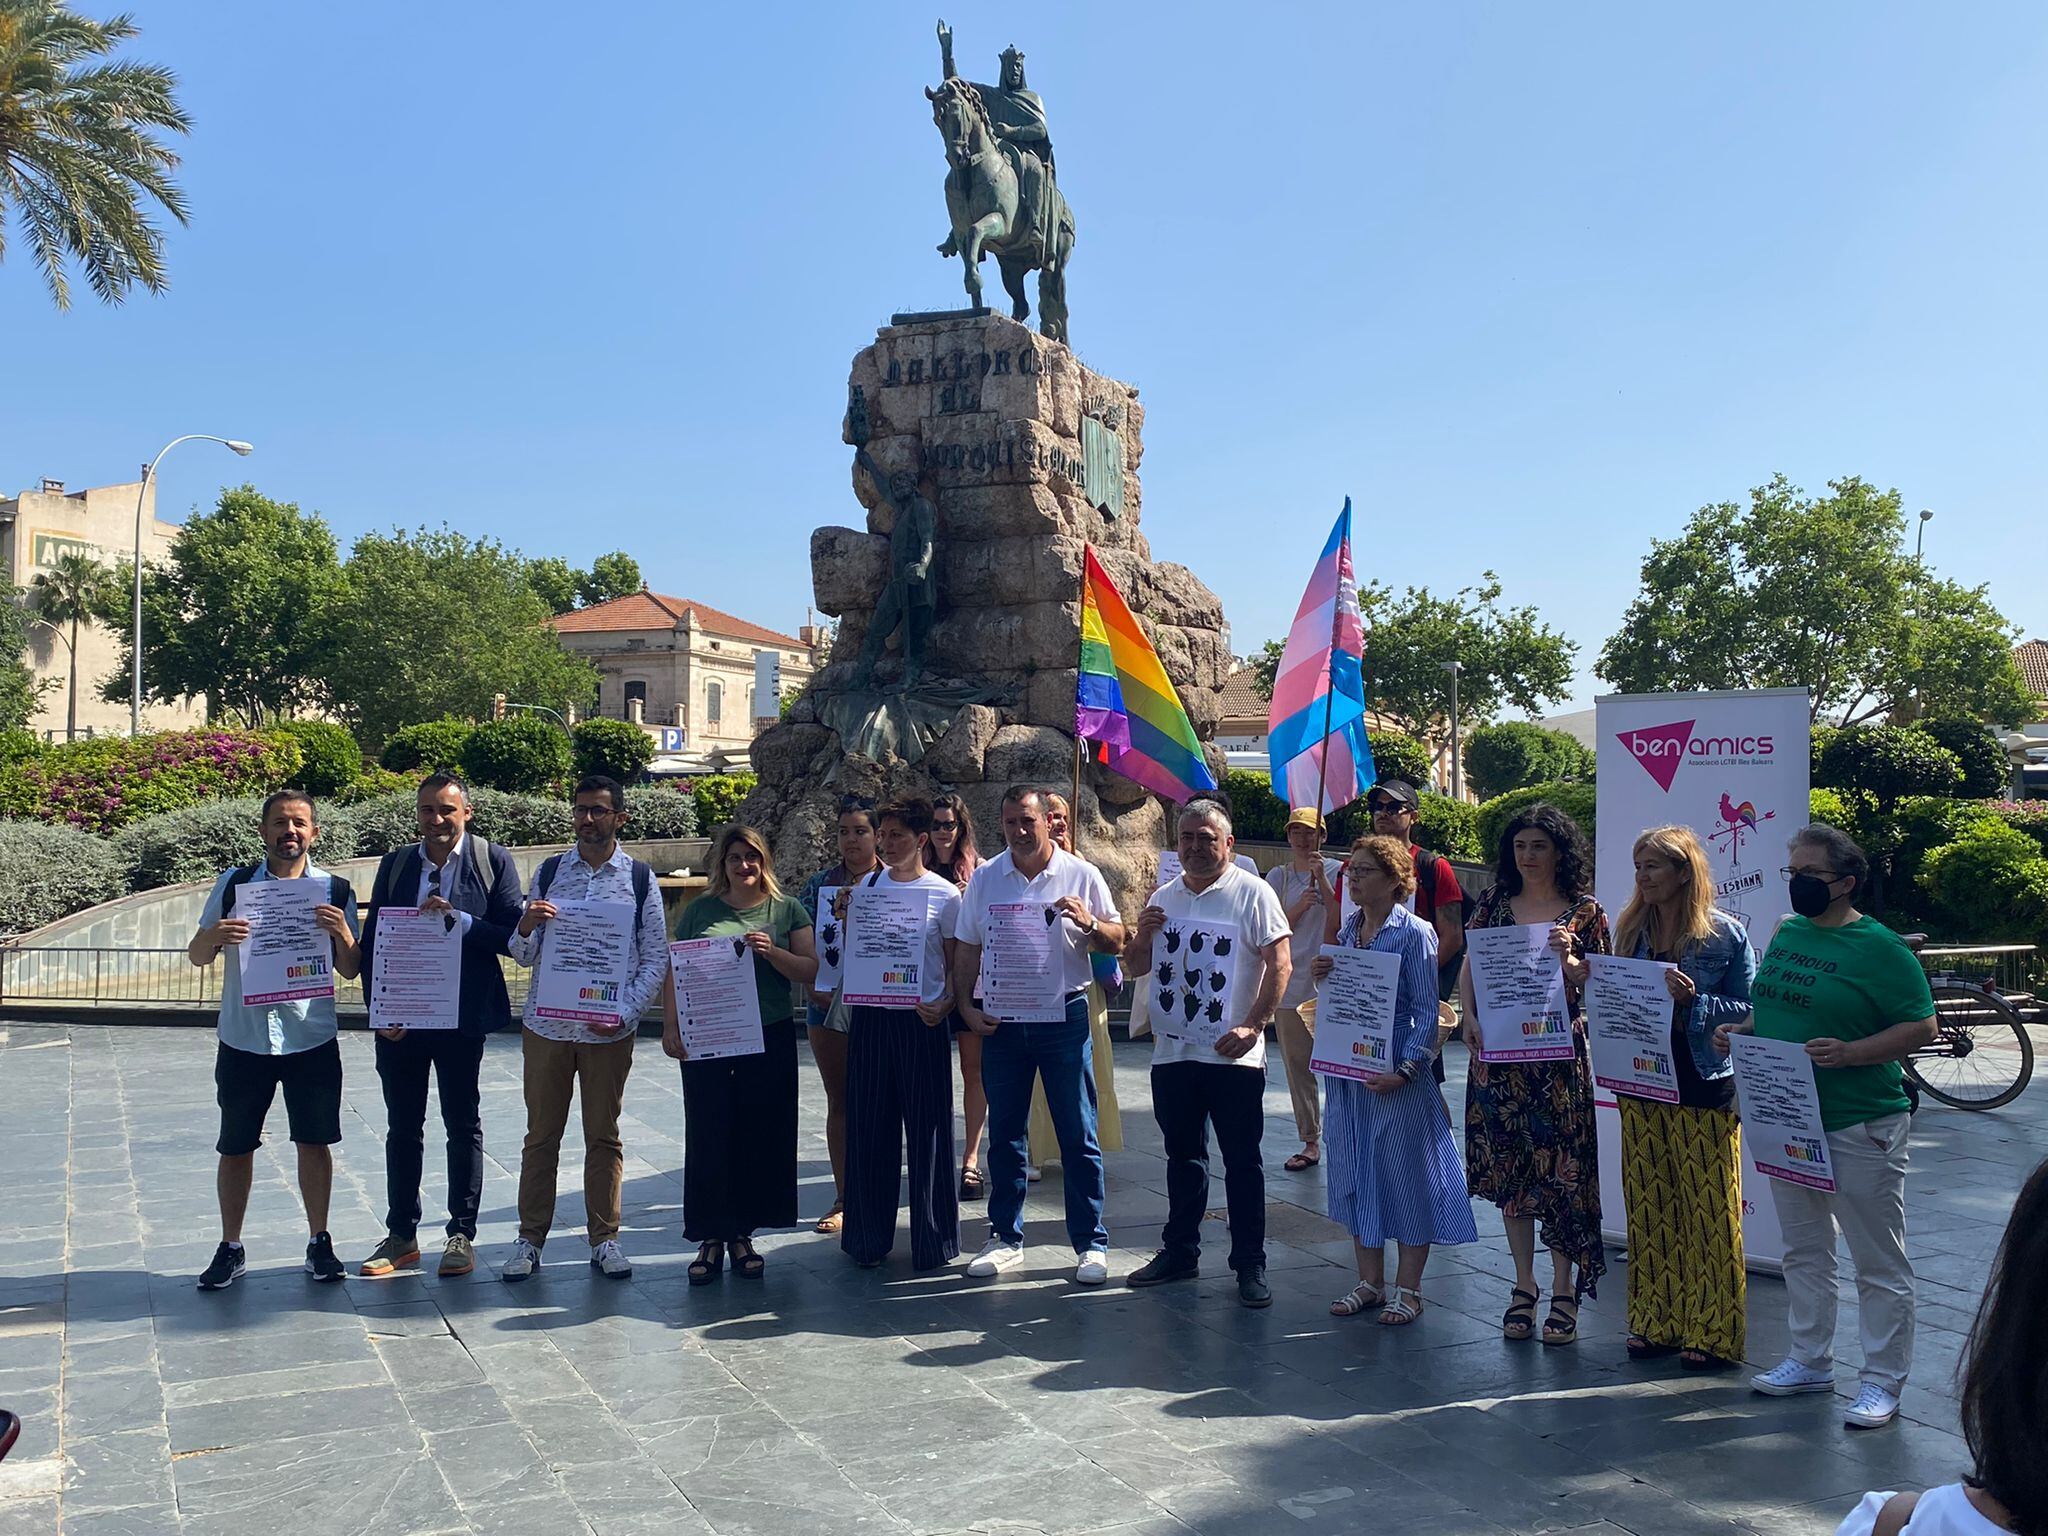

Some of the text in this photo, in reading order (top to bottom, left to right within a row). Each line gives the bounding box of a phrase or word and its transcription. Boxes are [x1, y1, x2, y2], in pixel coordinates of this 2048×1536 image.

[667, 731, 678, 748] P
[1632, 733, 1774, 756] ben amics
[1716, 873, 1762, 896] LESBIANA
[1768, 947, 1838, 974] BE PROUD
[1762, 964, 1817, 987] OF WHO
[1781, 991, 1813, 1009] ARE
